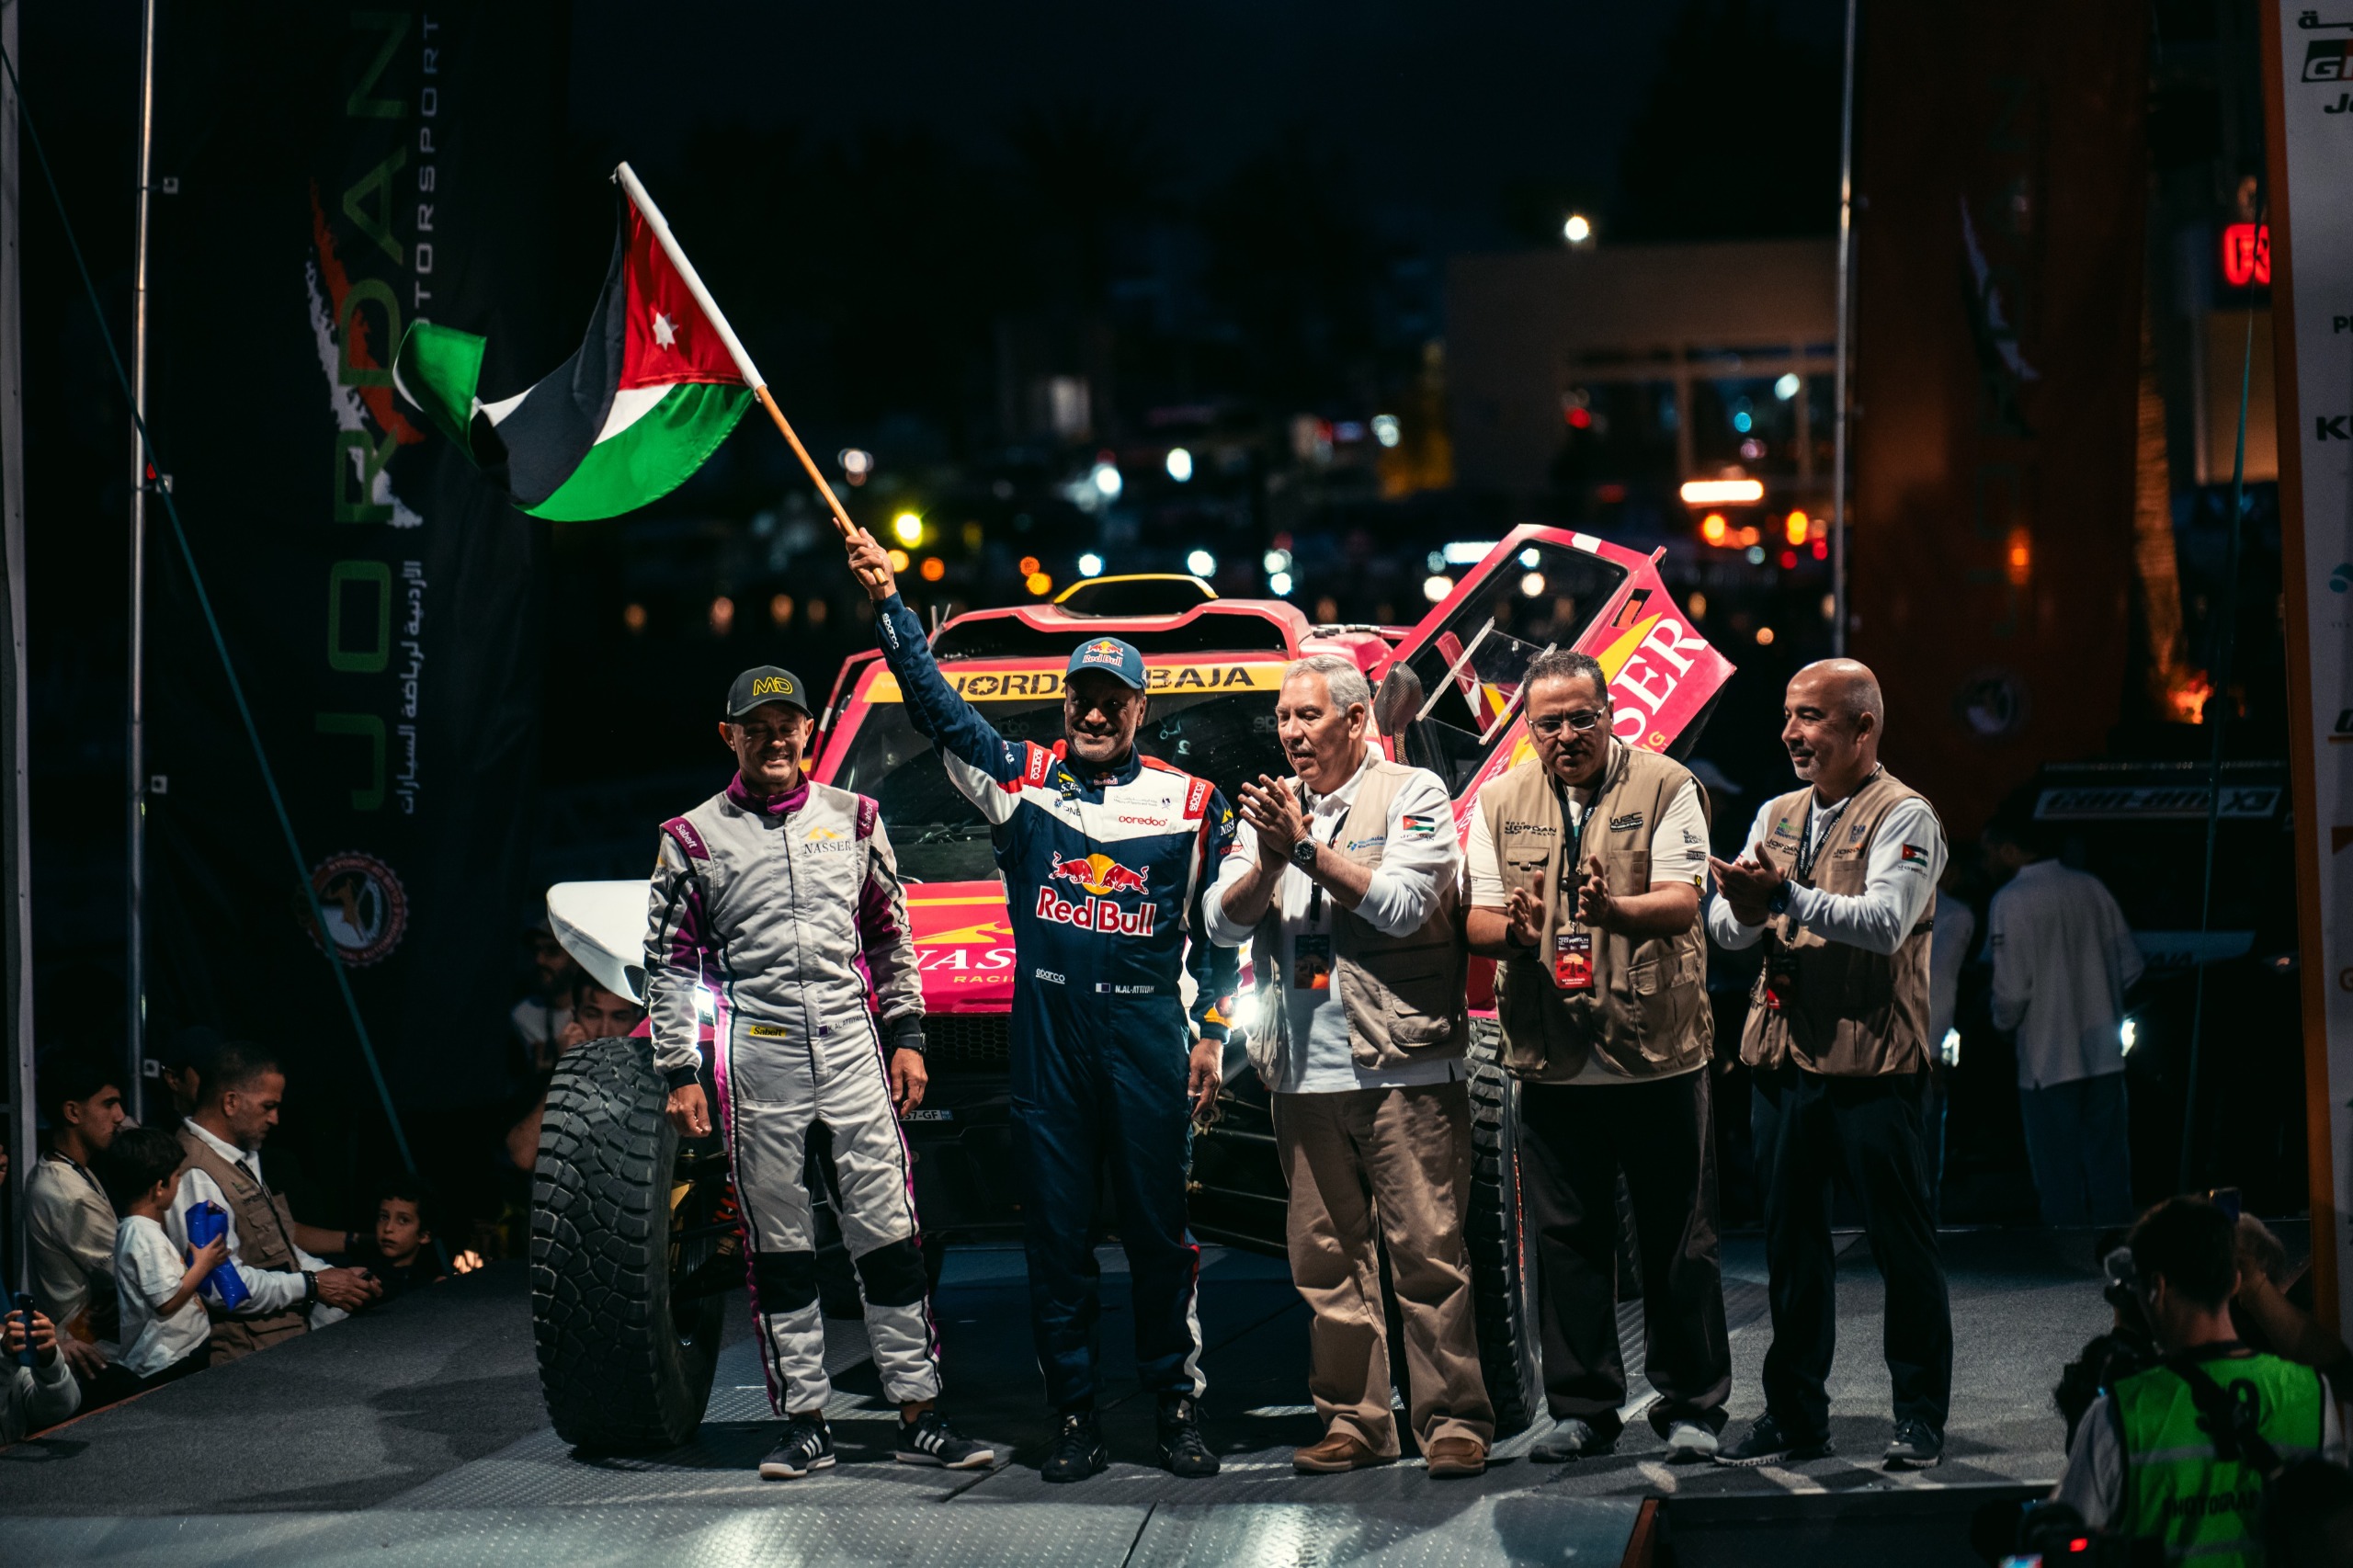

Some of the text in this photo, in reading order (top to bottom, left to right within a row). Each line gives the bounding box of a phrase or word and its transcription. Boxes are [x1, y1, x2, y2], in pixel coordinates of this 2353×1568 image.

[414, 13, 440, 324] TORSPORT
[314, 10, 412, 812] JORDAN
[881, 612, 900, 650] sparco
[1082, 653, 1123, 667] Red Bull
[1029, 747, 1044, 780] sparco
[1188, 781, 1207, 812] sparco
[861, 801, 873, 830] Sabelt
[1119, 816, 1168, 827] ooredoo
[676, 824, 698, 849] Sabelt
[1505, 824, 1557, 834] JORDAN
[804, 840, 852, 855] NASSER
[1766, 838, 1801, 855] JORDAN
[1035, 884, 1158, 937] Red Bull
[953, 975, 1015, 983] RACI
[1035, 968, 1065, 984] sparco
[752, 1026, 783, 1037] Sabelt
